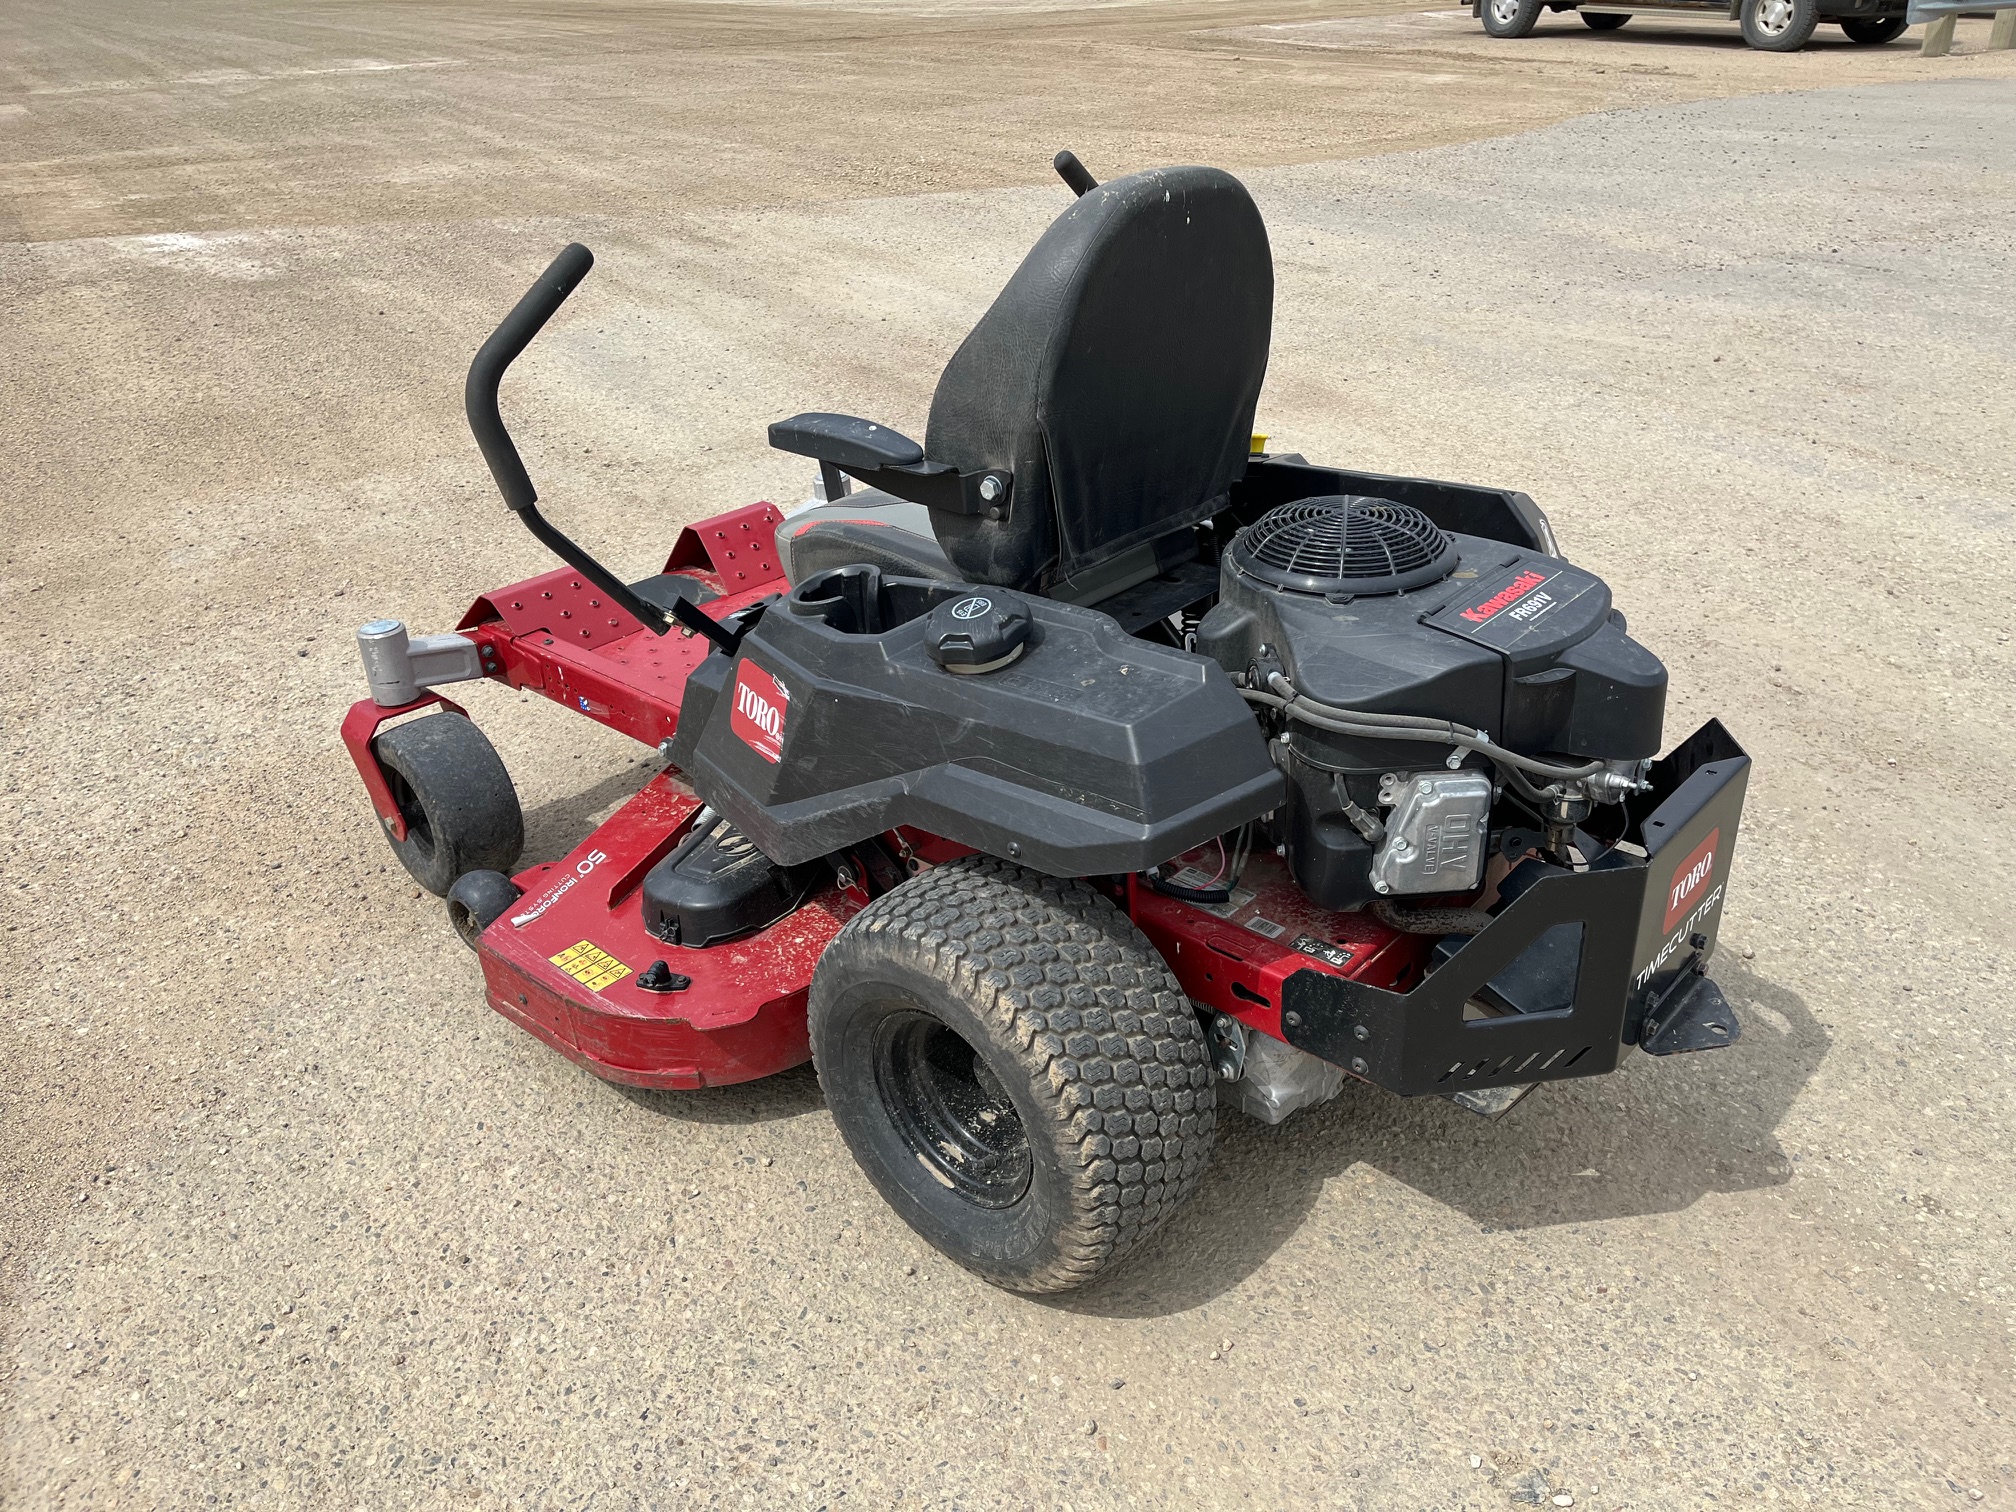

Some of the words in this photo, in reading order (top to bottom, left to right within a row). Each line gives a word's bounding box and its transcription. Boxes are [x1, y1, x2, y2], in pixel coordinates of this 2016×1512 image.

[1460, 570, 1546, 623] Kawasaki
[1508, 591, 1552, 621] FR691V
[737, 681, 780, 736] TORO
[1441, 813, 1472, 872] OHV
[519, 897, 543, 917] SYSTE
[530, 877, 579, 916] IRONFORC
[542, 873, 571, 898] CUTTING
[1671, 851, 1712, 911] TORO
[1636, 884, 1723, 991] TIMECUTTER
